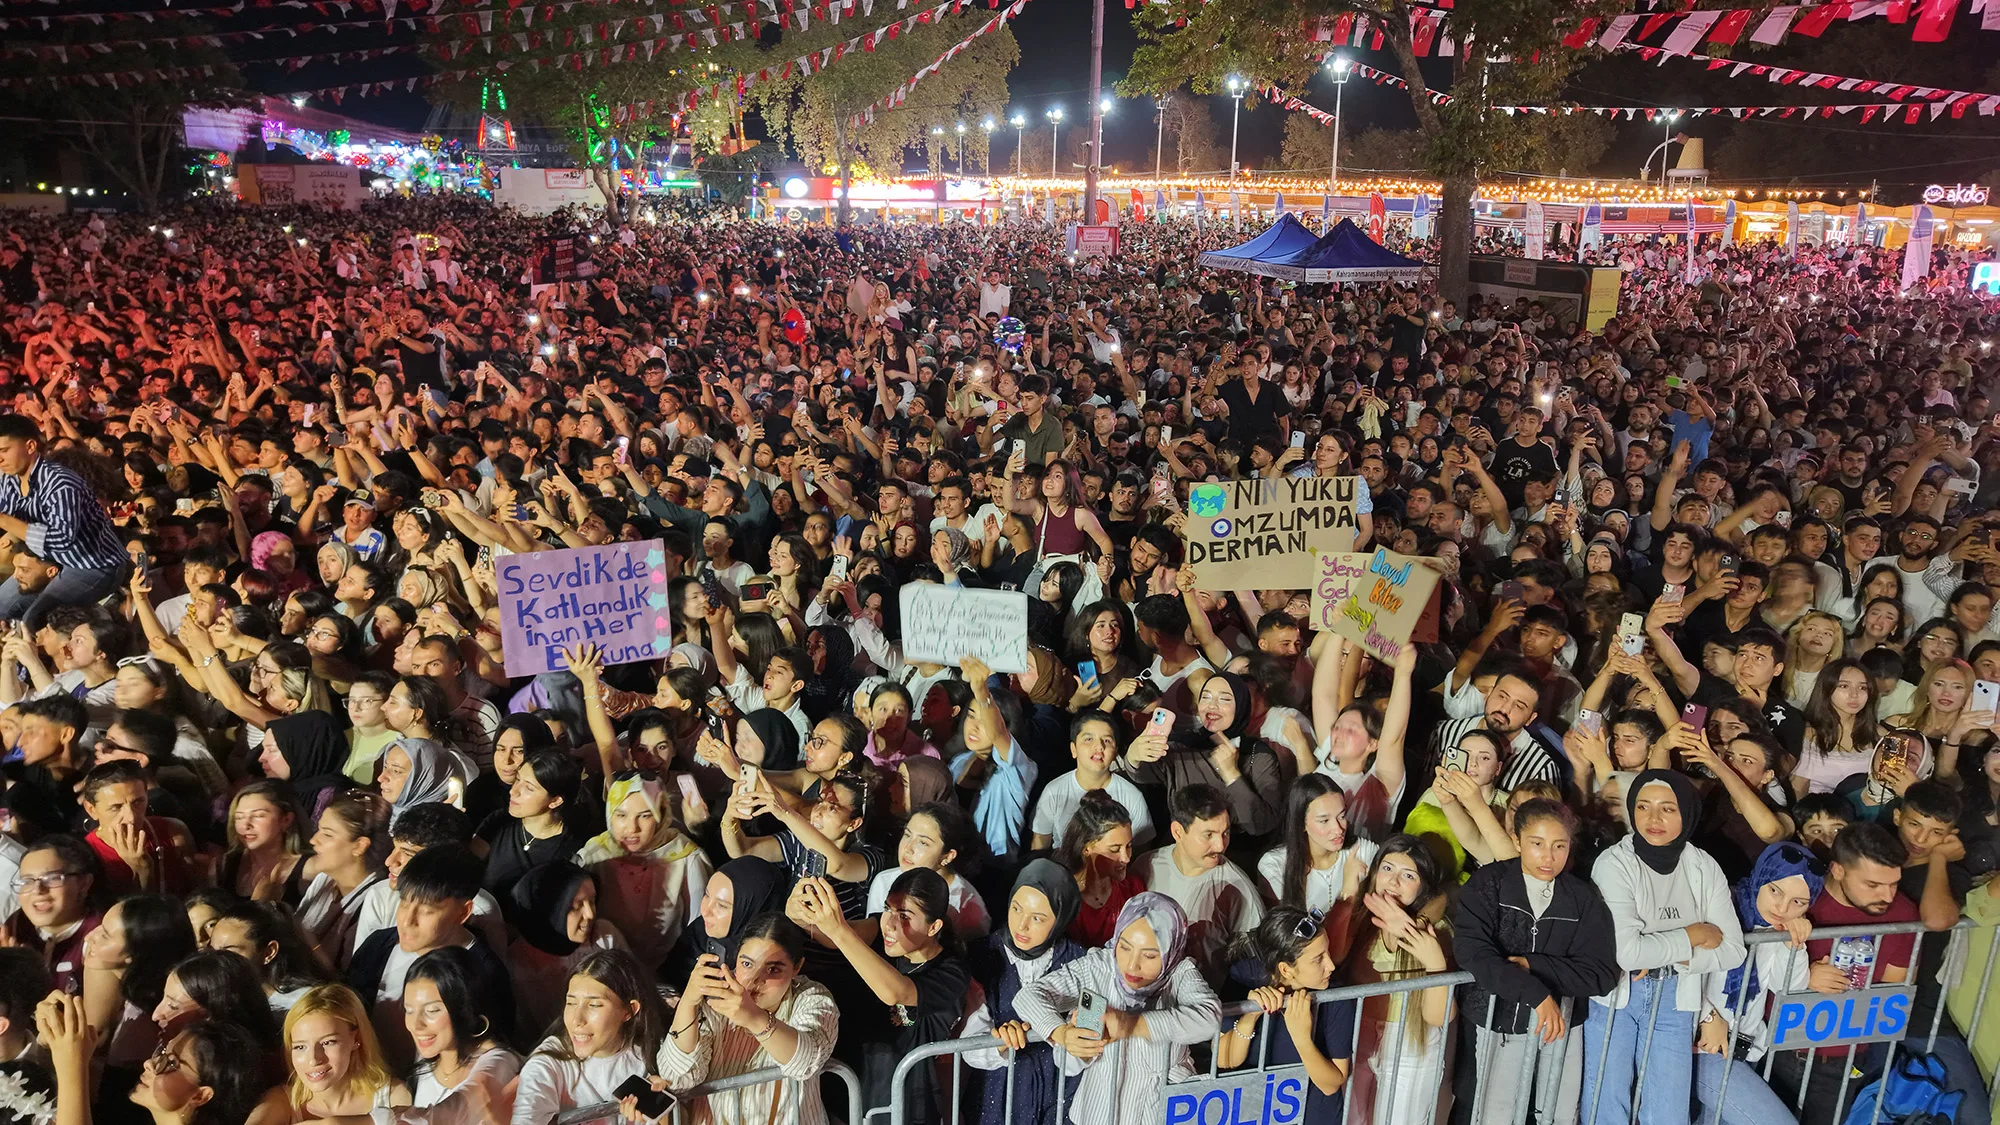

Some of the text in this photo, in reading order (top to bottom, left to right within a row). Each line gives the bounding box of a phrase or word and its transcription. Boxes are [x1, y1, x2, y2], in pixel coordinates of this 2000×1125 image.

[1400, 267, 1420, 279] Belediyes
[1508, 466, 1523, 478] LA
[1285, 477, 1354, 503] YÜKÜ
[1189, 531, 1307, 565] DERMANI
[503, 550, 648, 595] Sevdik'de
[583, 612, 643, 640] Her
[1659, 906, 1681, 919] ZARA
